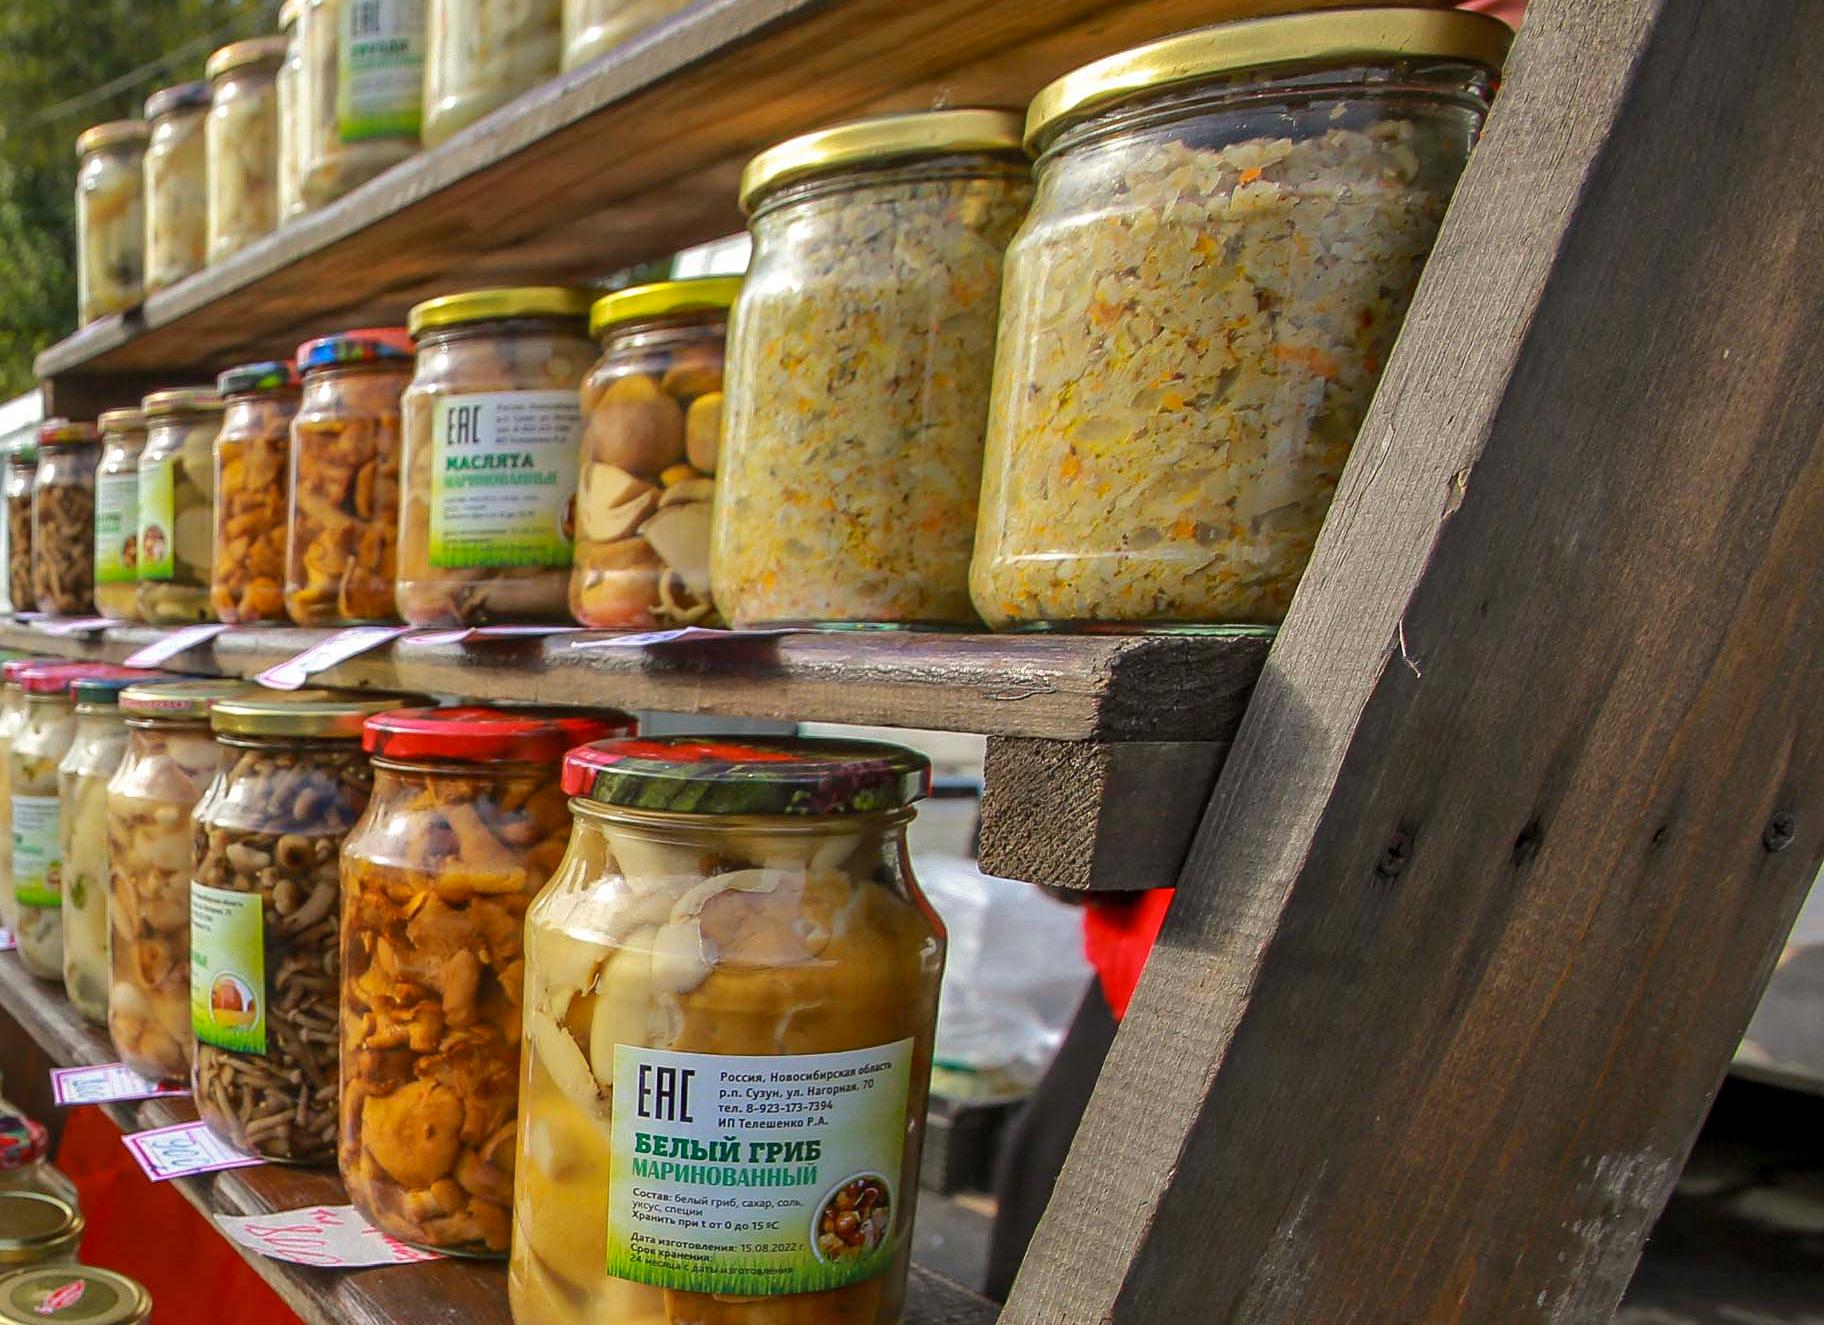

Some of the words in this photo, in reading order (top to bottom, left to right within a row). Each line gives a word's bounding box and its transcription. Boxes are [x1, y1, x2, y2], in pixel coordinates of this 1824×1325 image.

[446, 452, 534, 470] МАСЛЯТА
[720, 1071, 766, 1084] Россия,
[770, 1068, 856, 1083] Новосибирская
[858, 1061, 892, 1075] область
[638, 1064, 695, 1123] EAC
[719, 1089, 742, 1100] р.п.
[746, 1088, 783, 1100] Сузун,
[786, 1088, 804, 1100] ул.
[807, 1083, 860, 1097] Нагорная,
[863, 1079, 875, 1090] 70
[718, 1103, 743, 1114] тел.
[746, 1101, 833, 1114] 8-923-173-7394
[718, 1117, 735, 1128] ИП
[738, 1117, 804, 1129] Телешенко
[807, 1116, 829, 1126] Р.А.
[635, 1132, 740, 1163] БЕЛЫЙ
[748, 1140, 822, 1163] ГРИБ
[632, 1157, 818, 1187] МАРИНОВАННЫЙ
[632, 1187, 673, 1202] Состав:
[674, 1193, 709, 1207] белый
[711, 1197, 739, 1210] гриб,
[742, 1200, 775, 1210] сахар,
[632, 1201, 663, 1214] уксус,
[665, 1206, 703, 1217] специи
[632, 1210, 676, 1226] Хранить
[678, 1218, 699, 1229] при
[701, 1219, 707, 1228] t
[709, 1221, 723, 1229] от
[725, 1221, 732, 1230] 0
[734, 1222, 749, 1231] до
[752, 1221, 764, 1230] 15
[631, 1232, 657, 1244] Дата
[658, 1238, 738, 1252] изготовления:
[630, 1243, 656, 1256] Срок
[658, 1249, 713, 1262] хранения:
[645, 1258, 681, 1271] месяца
